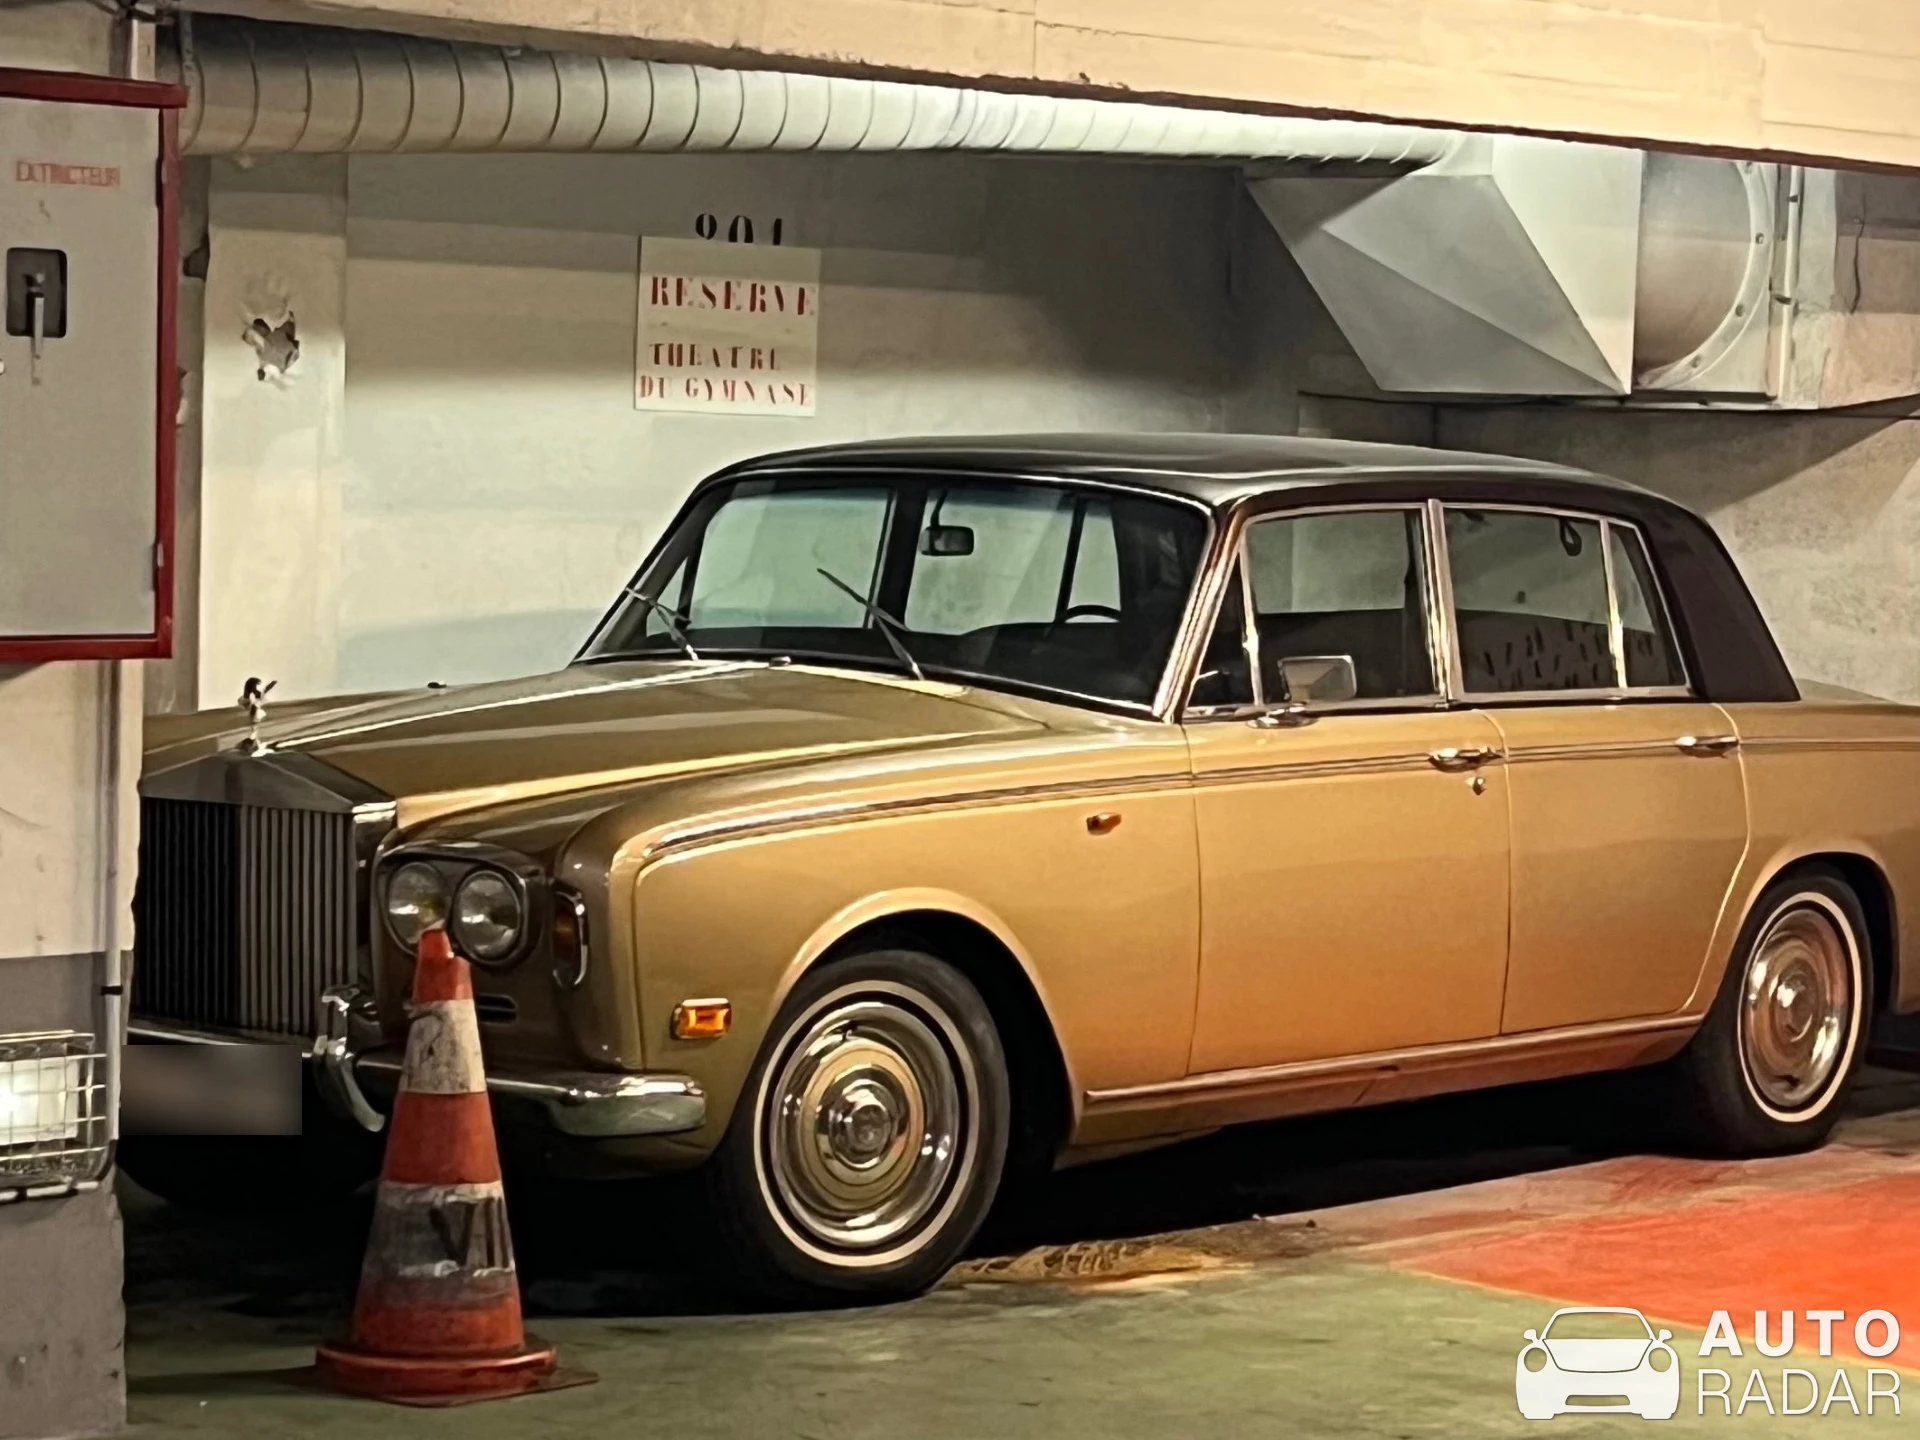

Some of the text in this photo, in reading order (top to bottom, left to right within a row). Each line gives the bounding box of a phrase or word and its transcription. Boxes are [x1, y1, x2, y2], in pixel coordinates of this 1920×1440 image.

[16, 160, 120, 187] EXTCTEUR
[651, 276, 815, 316] RESERVE
[649, 343, 781, 371] THEATRE
[685, 378, 812, 406] GYMNASE
